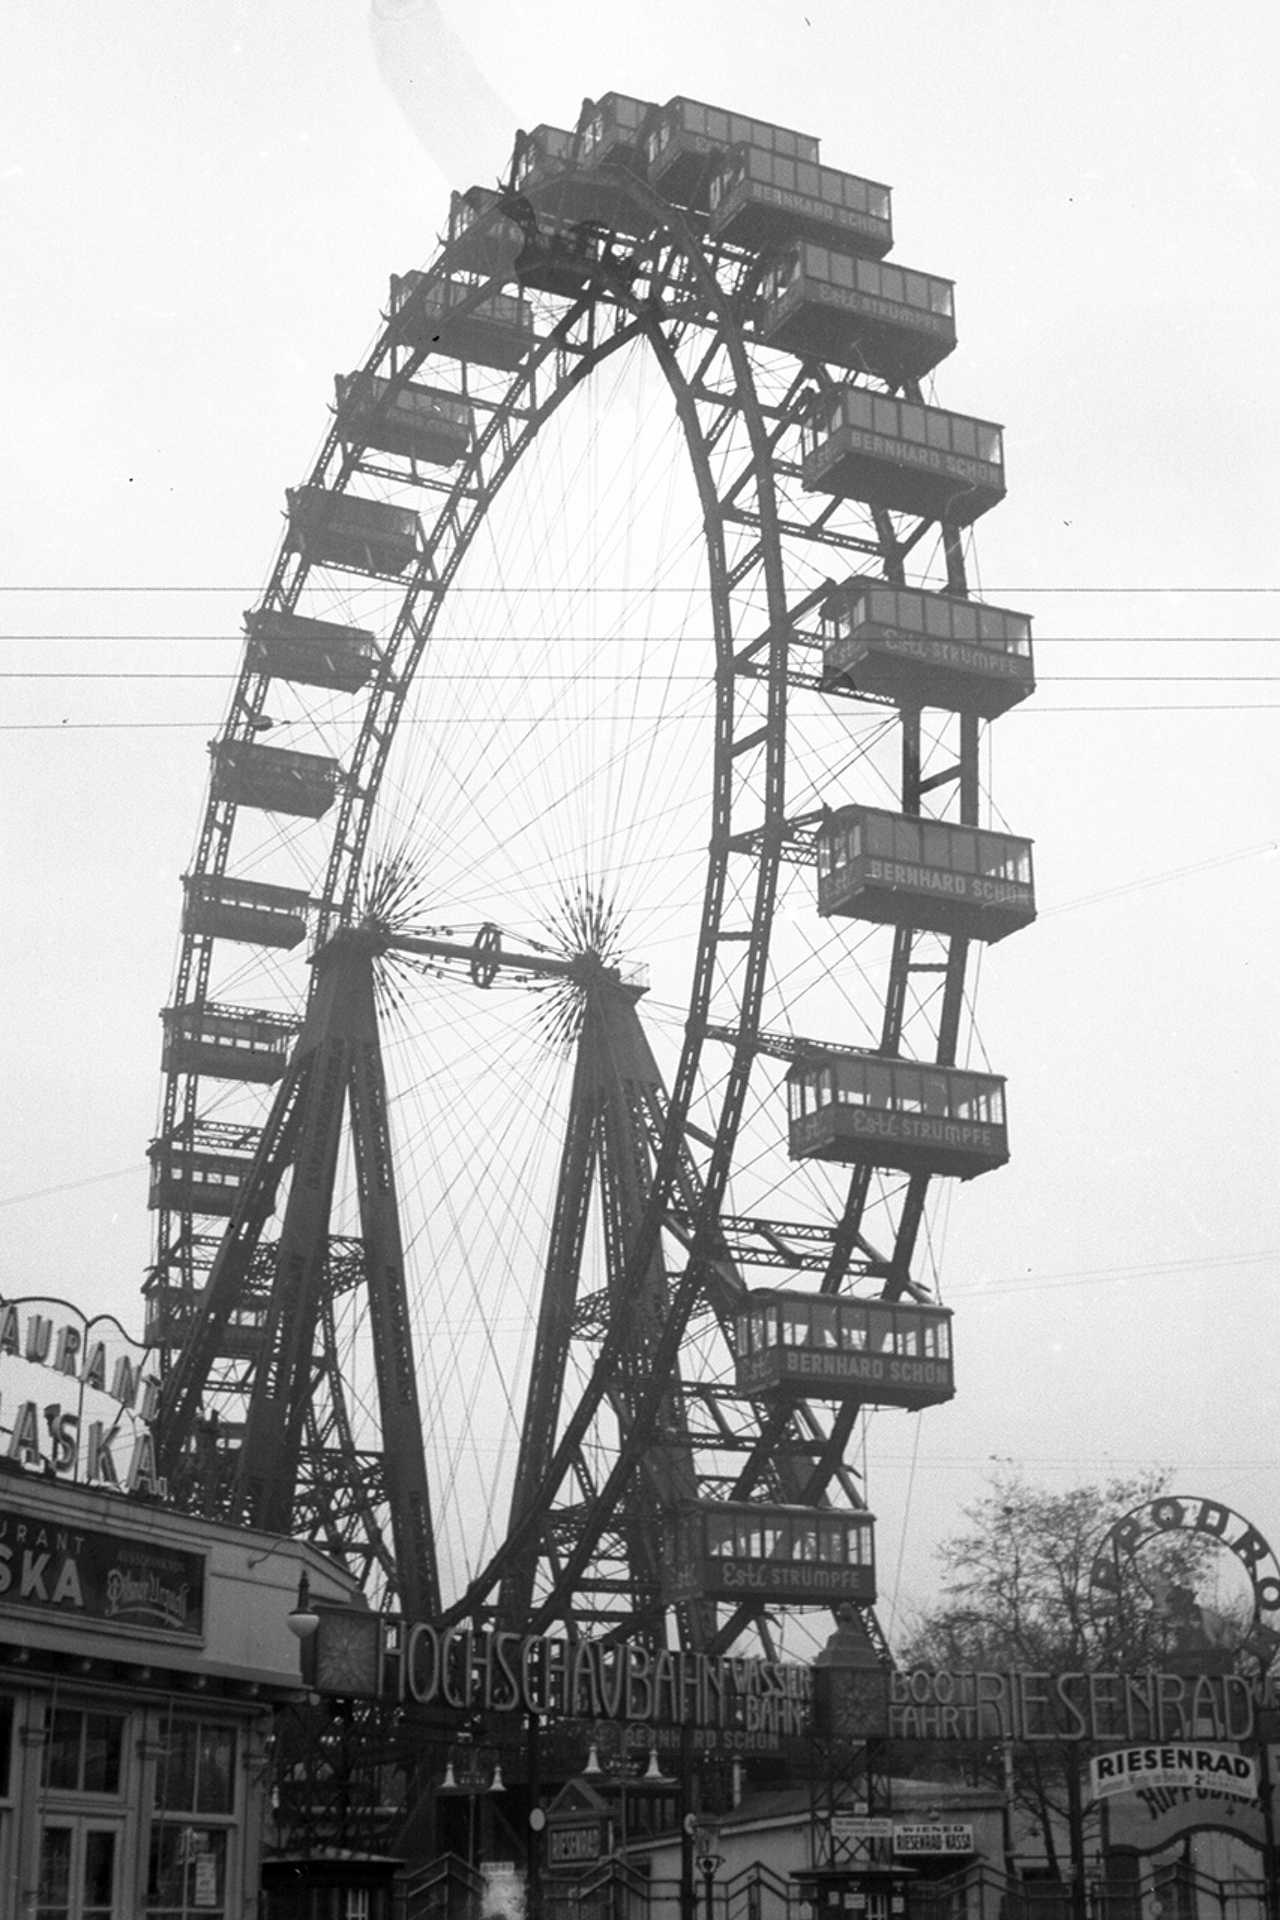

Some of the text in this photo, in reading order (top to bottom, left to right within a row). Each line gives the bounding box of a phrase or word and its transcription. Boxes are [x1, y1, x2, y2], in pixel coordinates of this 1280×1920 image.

[851, 431, 939, 468] BERNHARD
[871, 860, 966, 895] BERNHARD
[787, 1351, 884, 1380] BERNHARD
[731, 1659, 813, 1700] WASSER
[746, 1695, 802, 1737] BAHN
[888, 1705, 977, 1739] FAHRT
[977, 1671, 1255, 1740] RIESENRAD
[1097, 1748, 1251, 1780] RIESENRAD
